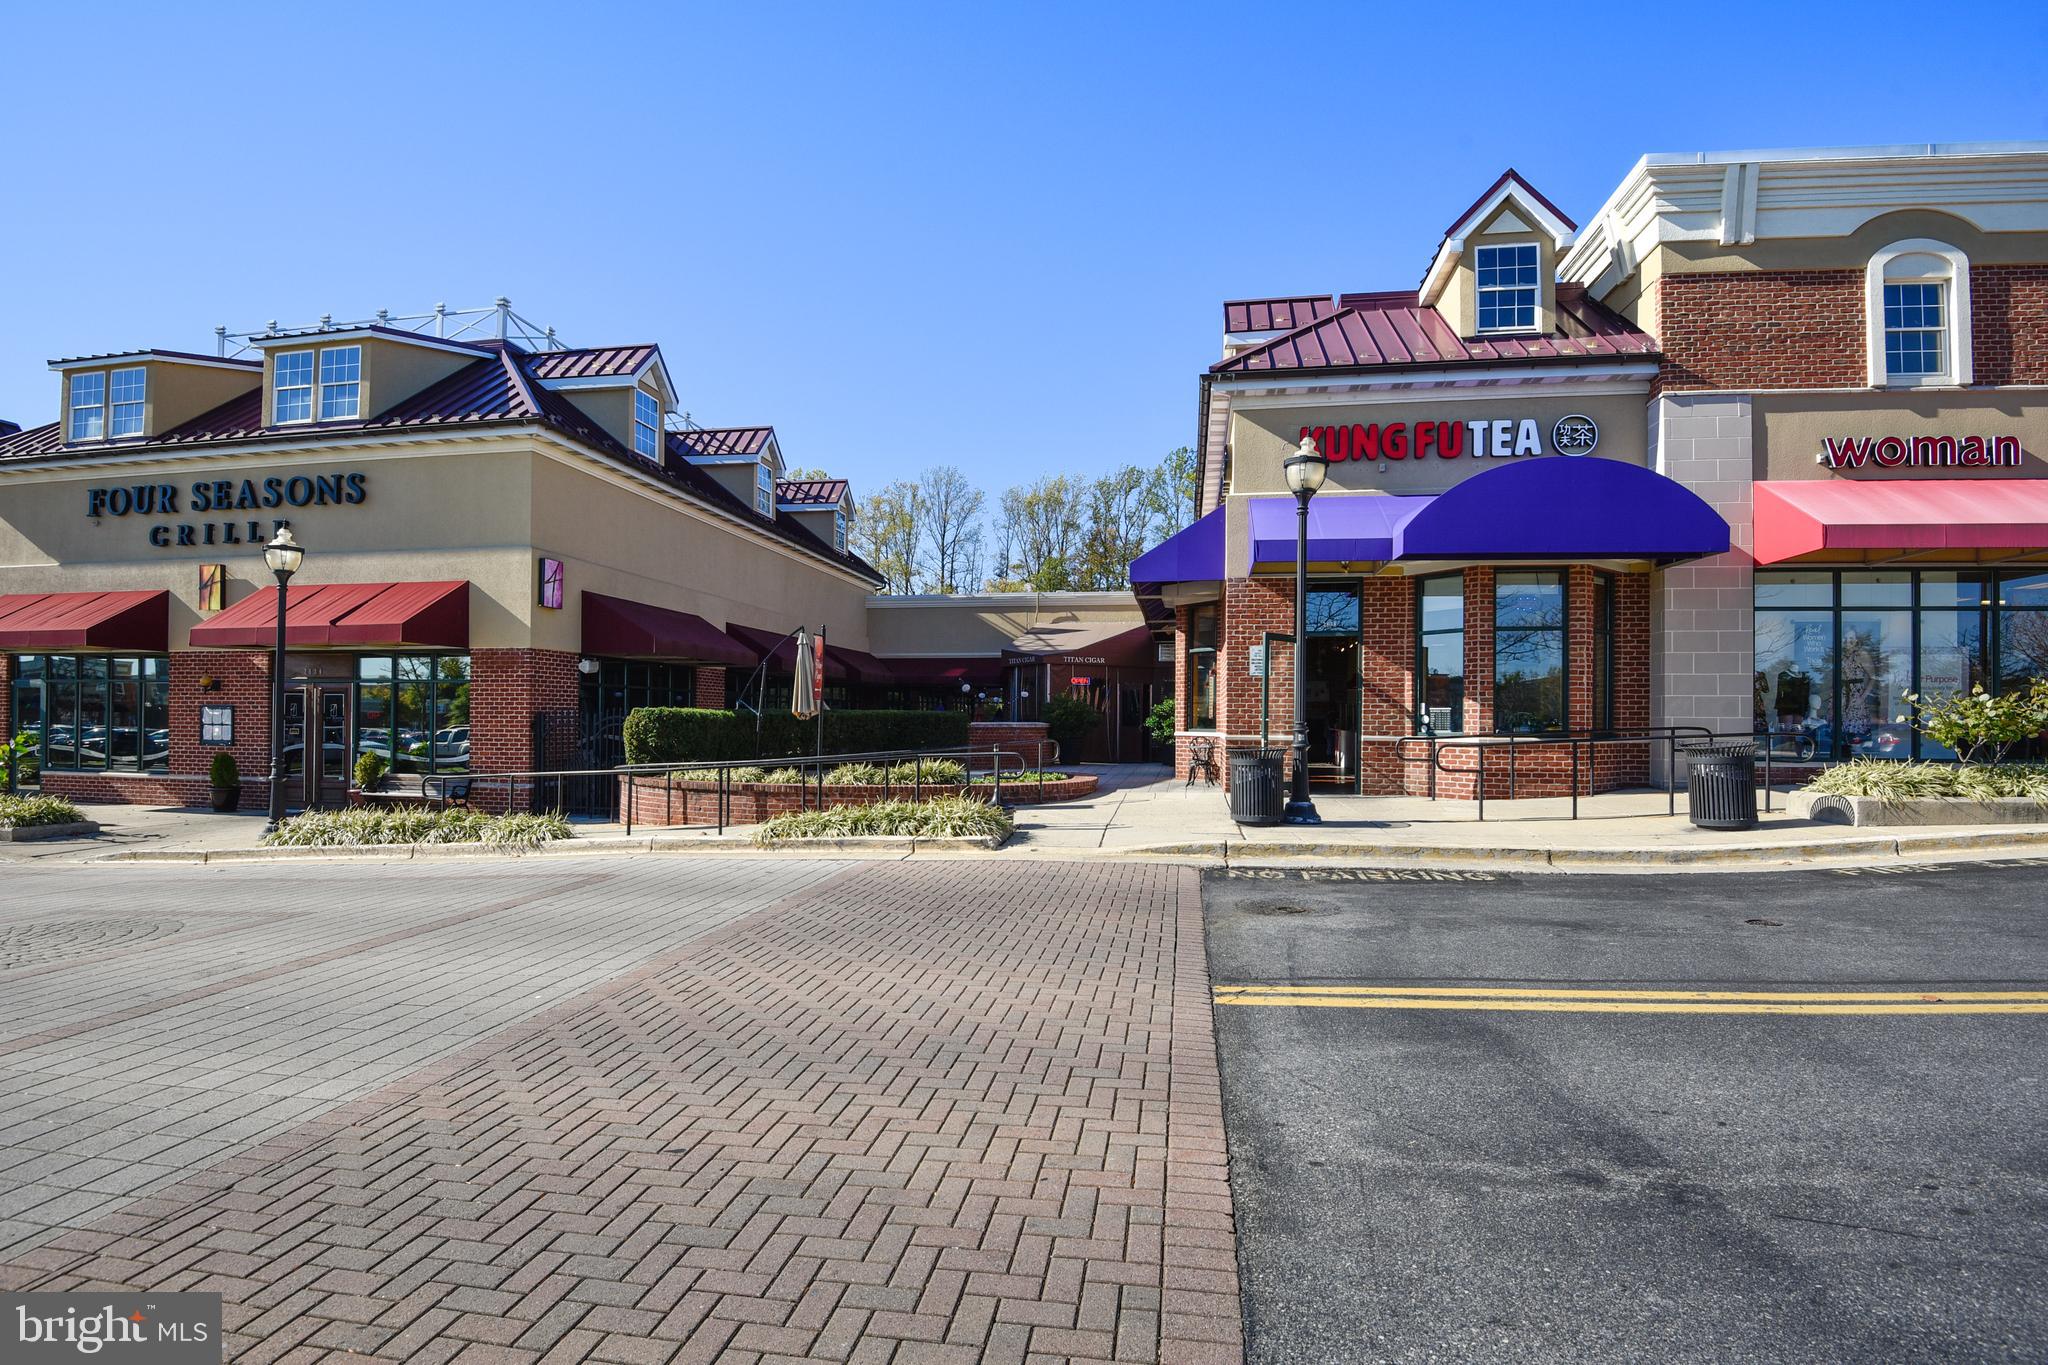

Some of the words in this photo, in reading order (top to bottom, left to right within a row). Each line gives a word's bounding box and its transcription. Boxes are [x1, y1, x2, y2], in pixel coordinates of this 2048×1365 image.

[1299, 422, 1408, 462] KUNG
[1414, 420, 1464, 459] FU
[1467, 418, 1542, 458] TEA
[1824, 435, 2022, 468] woman
[86, 484, 178, 517] FOUR
[191, 473, 367, 512] SEASONS
[1084, 656, 1106, 664] CIGAR
[1071, 677, 1089, 685] OPEN
[1926, 675, 1958, 685] Purpose
[1227, 868, 1285, 879] NO
[1300, 869, 1497, 881] PARKING
